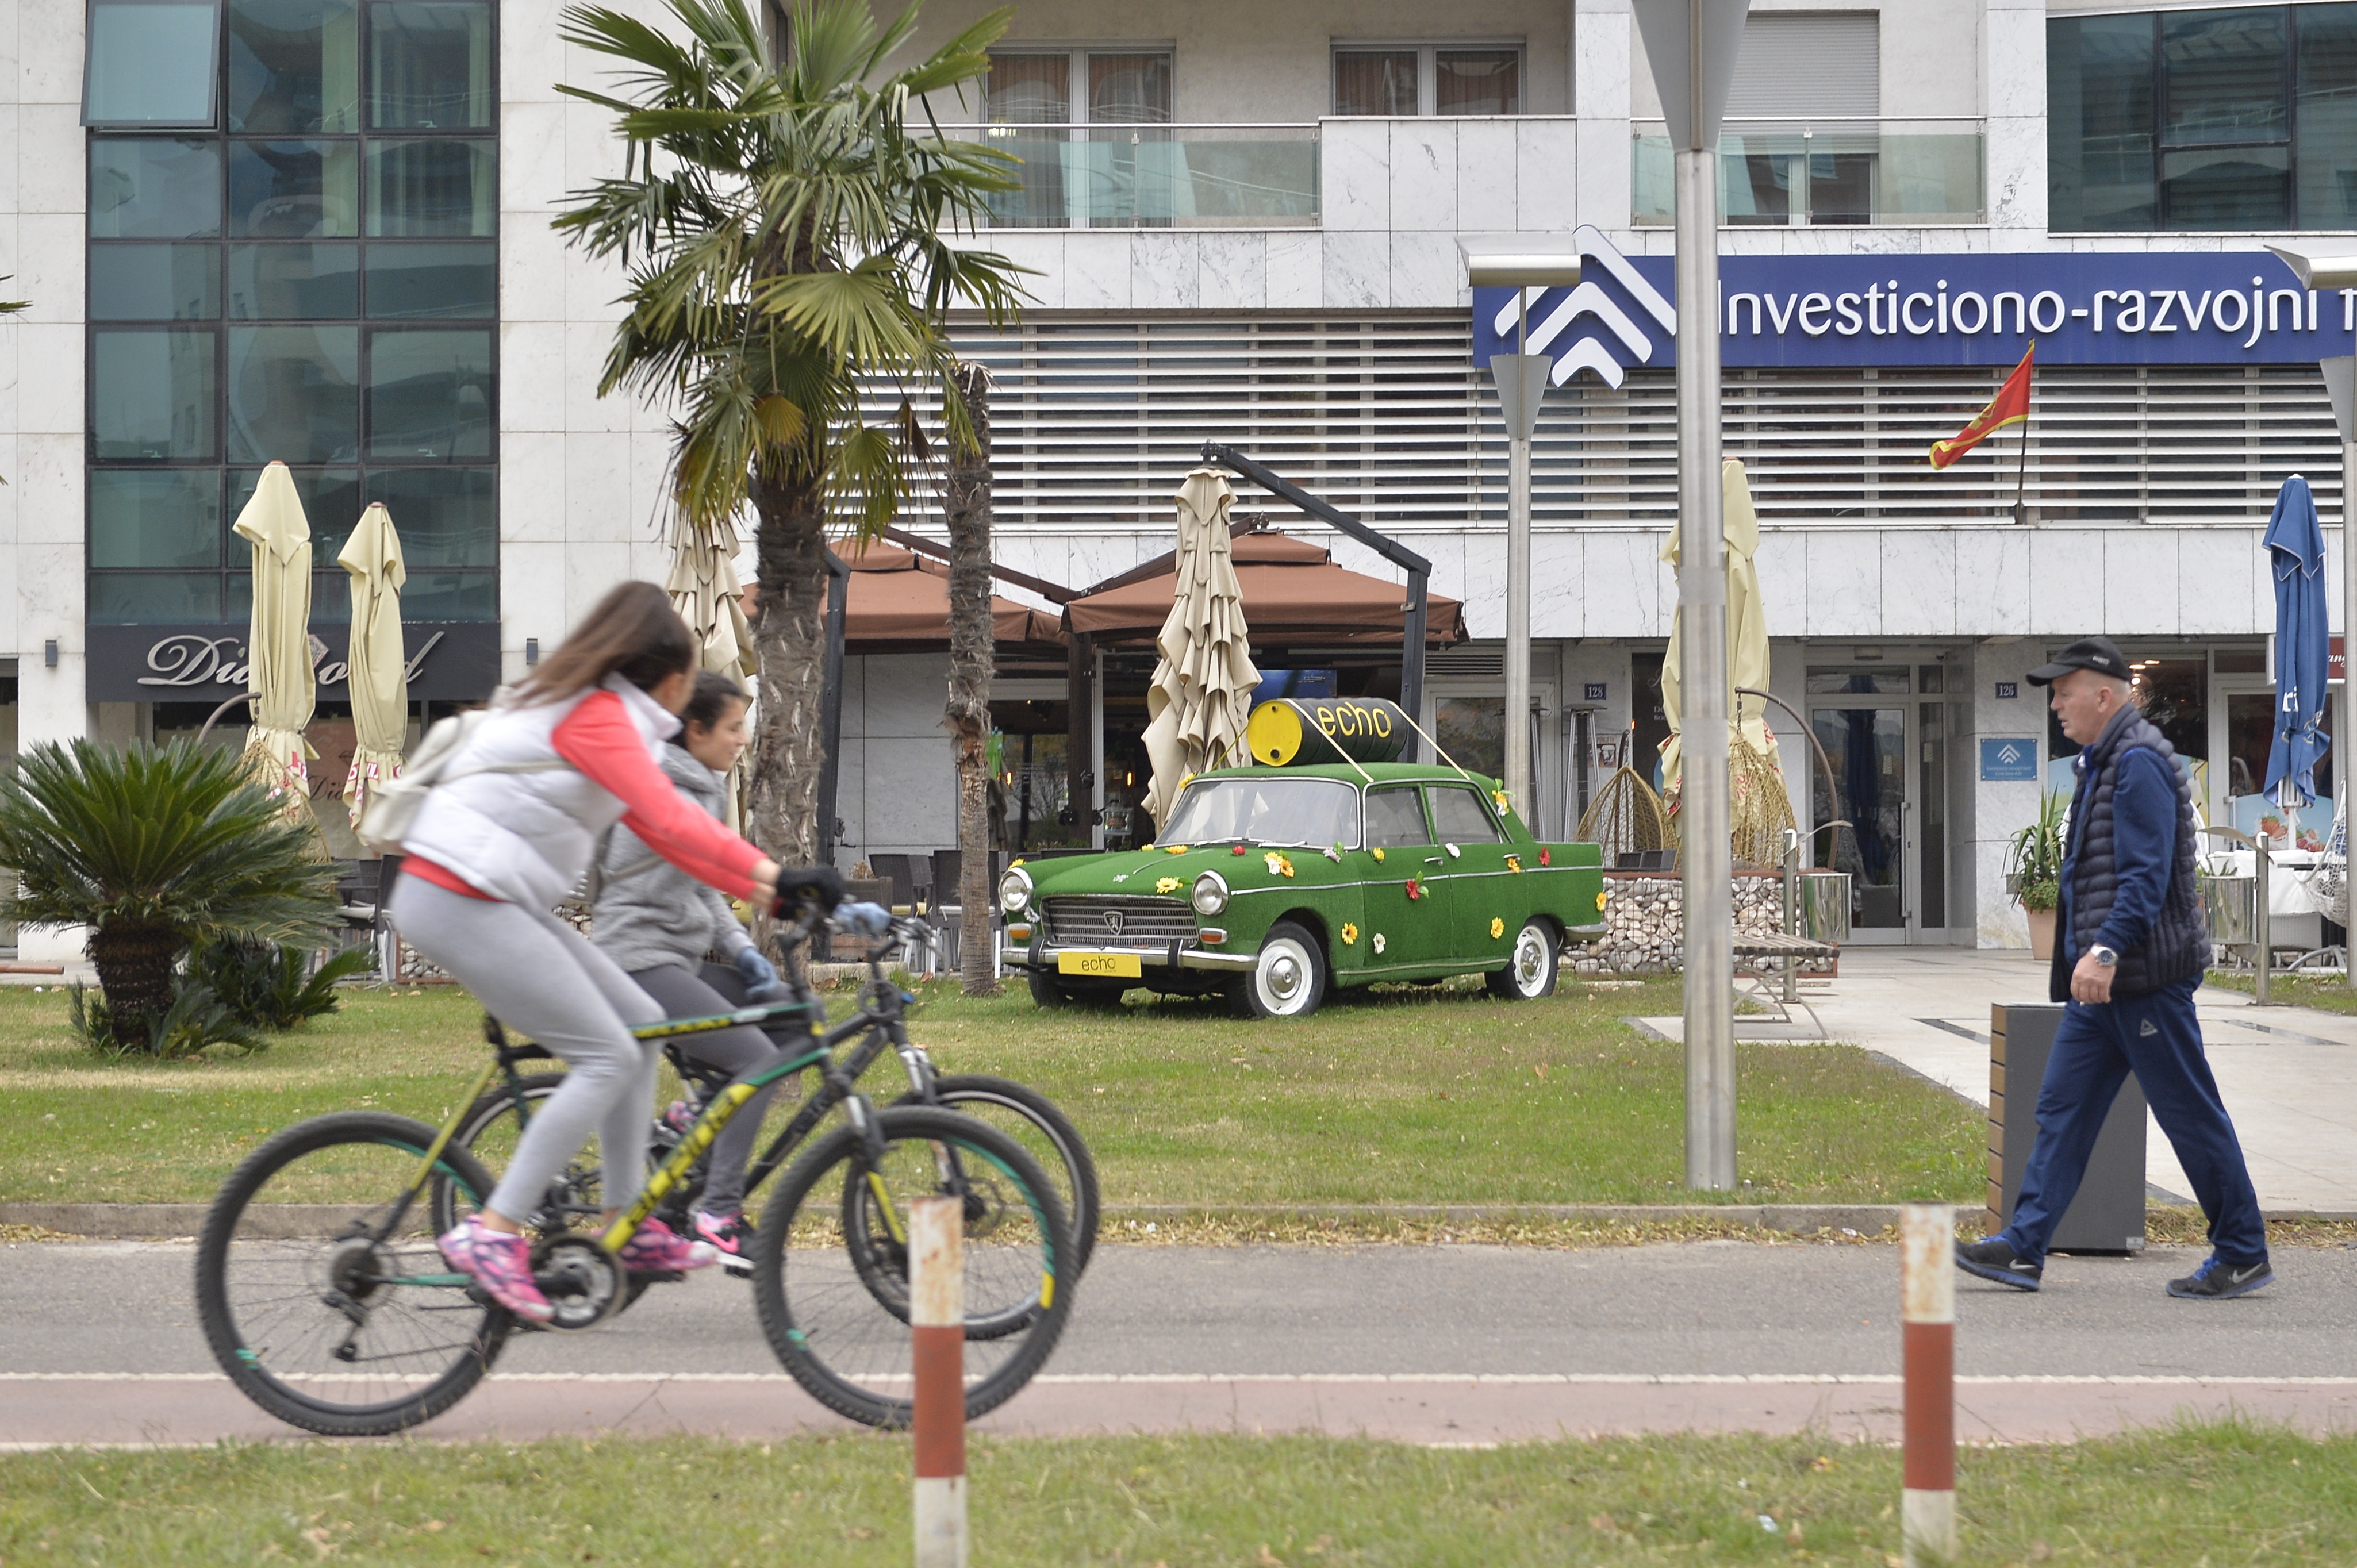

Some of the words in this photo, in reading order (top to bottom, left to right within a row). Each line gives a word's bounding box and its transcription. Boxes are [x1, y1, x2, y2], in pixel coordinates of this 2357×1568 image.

[1587, 686, 1603, 698] 128
[1998, 684, 2014, 696] 126
[1316, 701, 1392, 738] echo
[1081, 955, 1116, 971] echo
